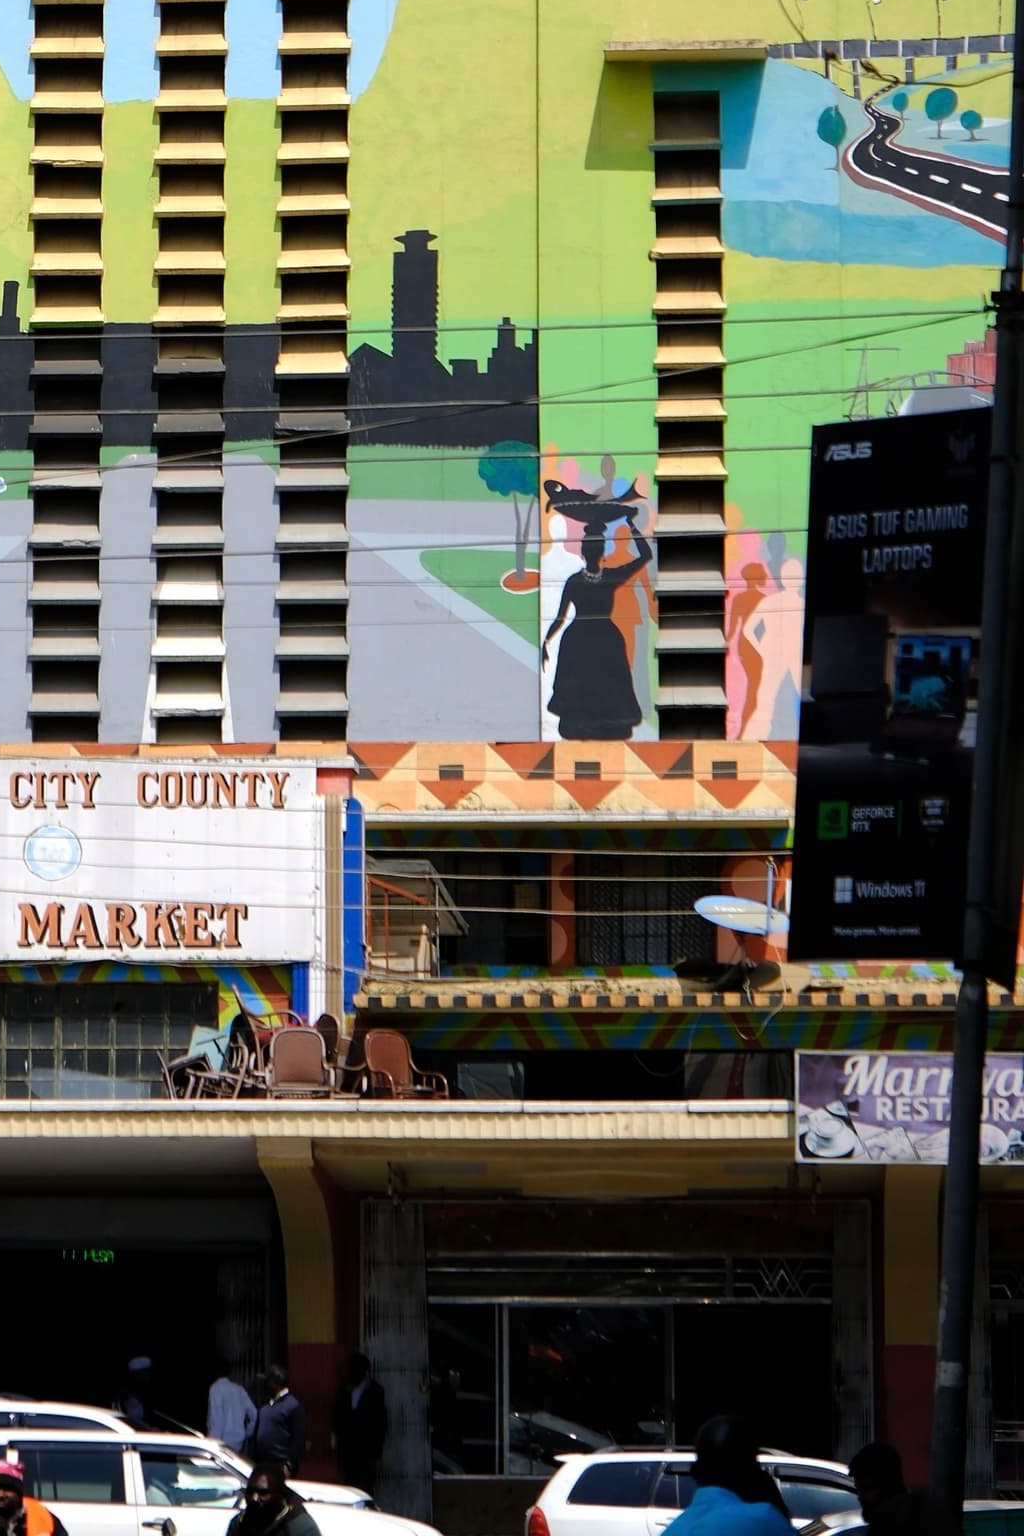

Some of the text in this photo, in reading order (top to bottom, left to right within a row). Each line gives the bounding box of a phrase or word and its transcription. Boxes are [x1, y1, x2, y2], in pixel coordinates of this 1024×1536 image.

[824, 441, 872, 462] ASUS
[824, 503, 968, 540] ASUS TUF GAMING
[862, 543, 933, 573] LAPTOPS
[9, 771, 101, 810] CITY
[136, 771, 290, 810] COUNTY
[851, 805, 896, 819] GEFORCE
[856, 880, 926, 898] Windows 11
[17, 902, 248, 949] MARKET
